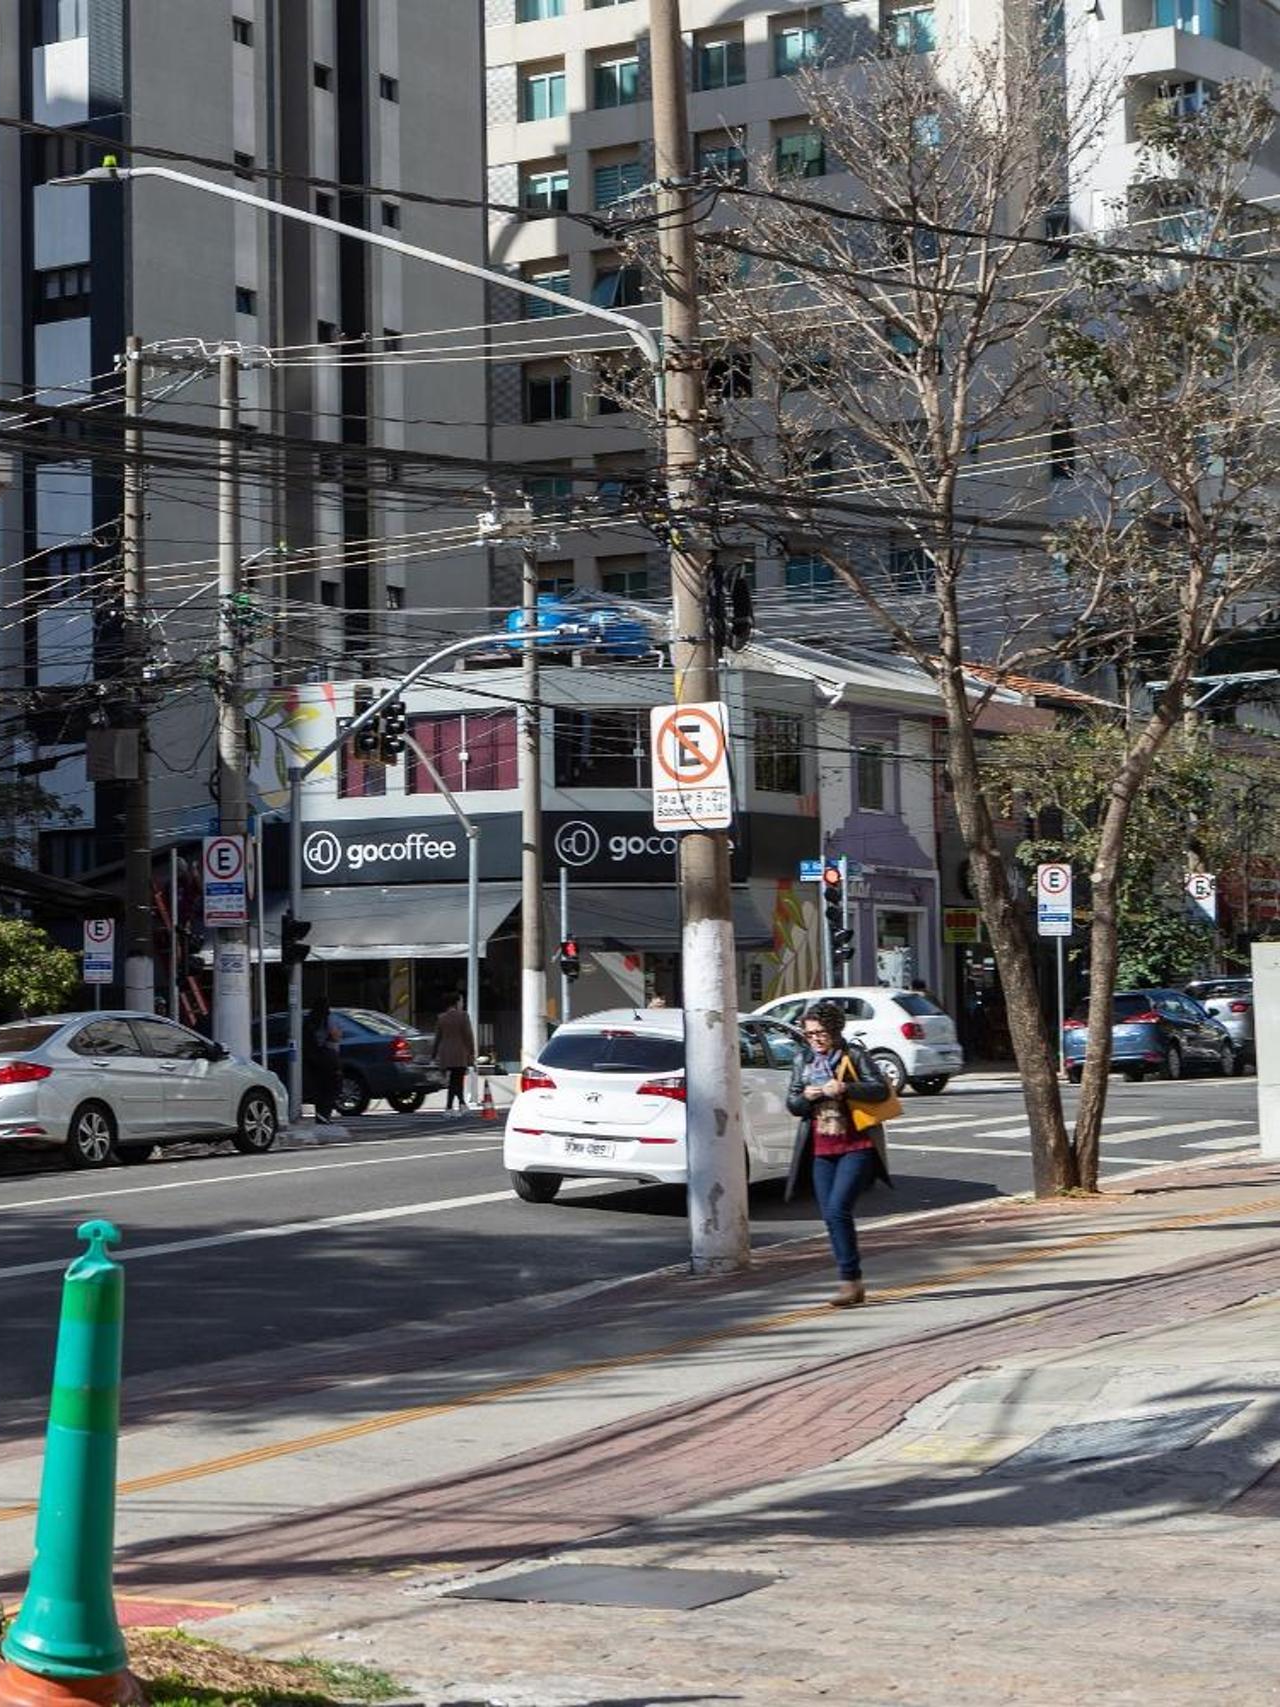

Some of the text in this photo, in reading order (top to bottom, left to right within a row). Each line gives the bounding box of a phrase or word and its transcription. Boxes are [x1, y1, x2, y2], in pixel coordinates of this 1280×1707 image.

[679, 725, 701, 767] E
[218, 848, 231, 871] E
[346, 833, 457, 869] gocoffee
[608, 836, 735, 861] goco
[1049, 871, 1059, 888] E
[95, 921, 104, 936] E
